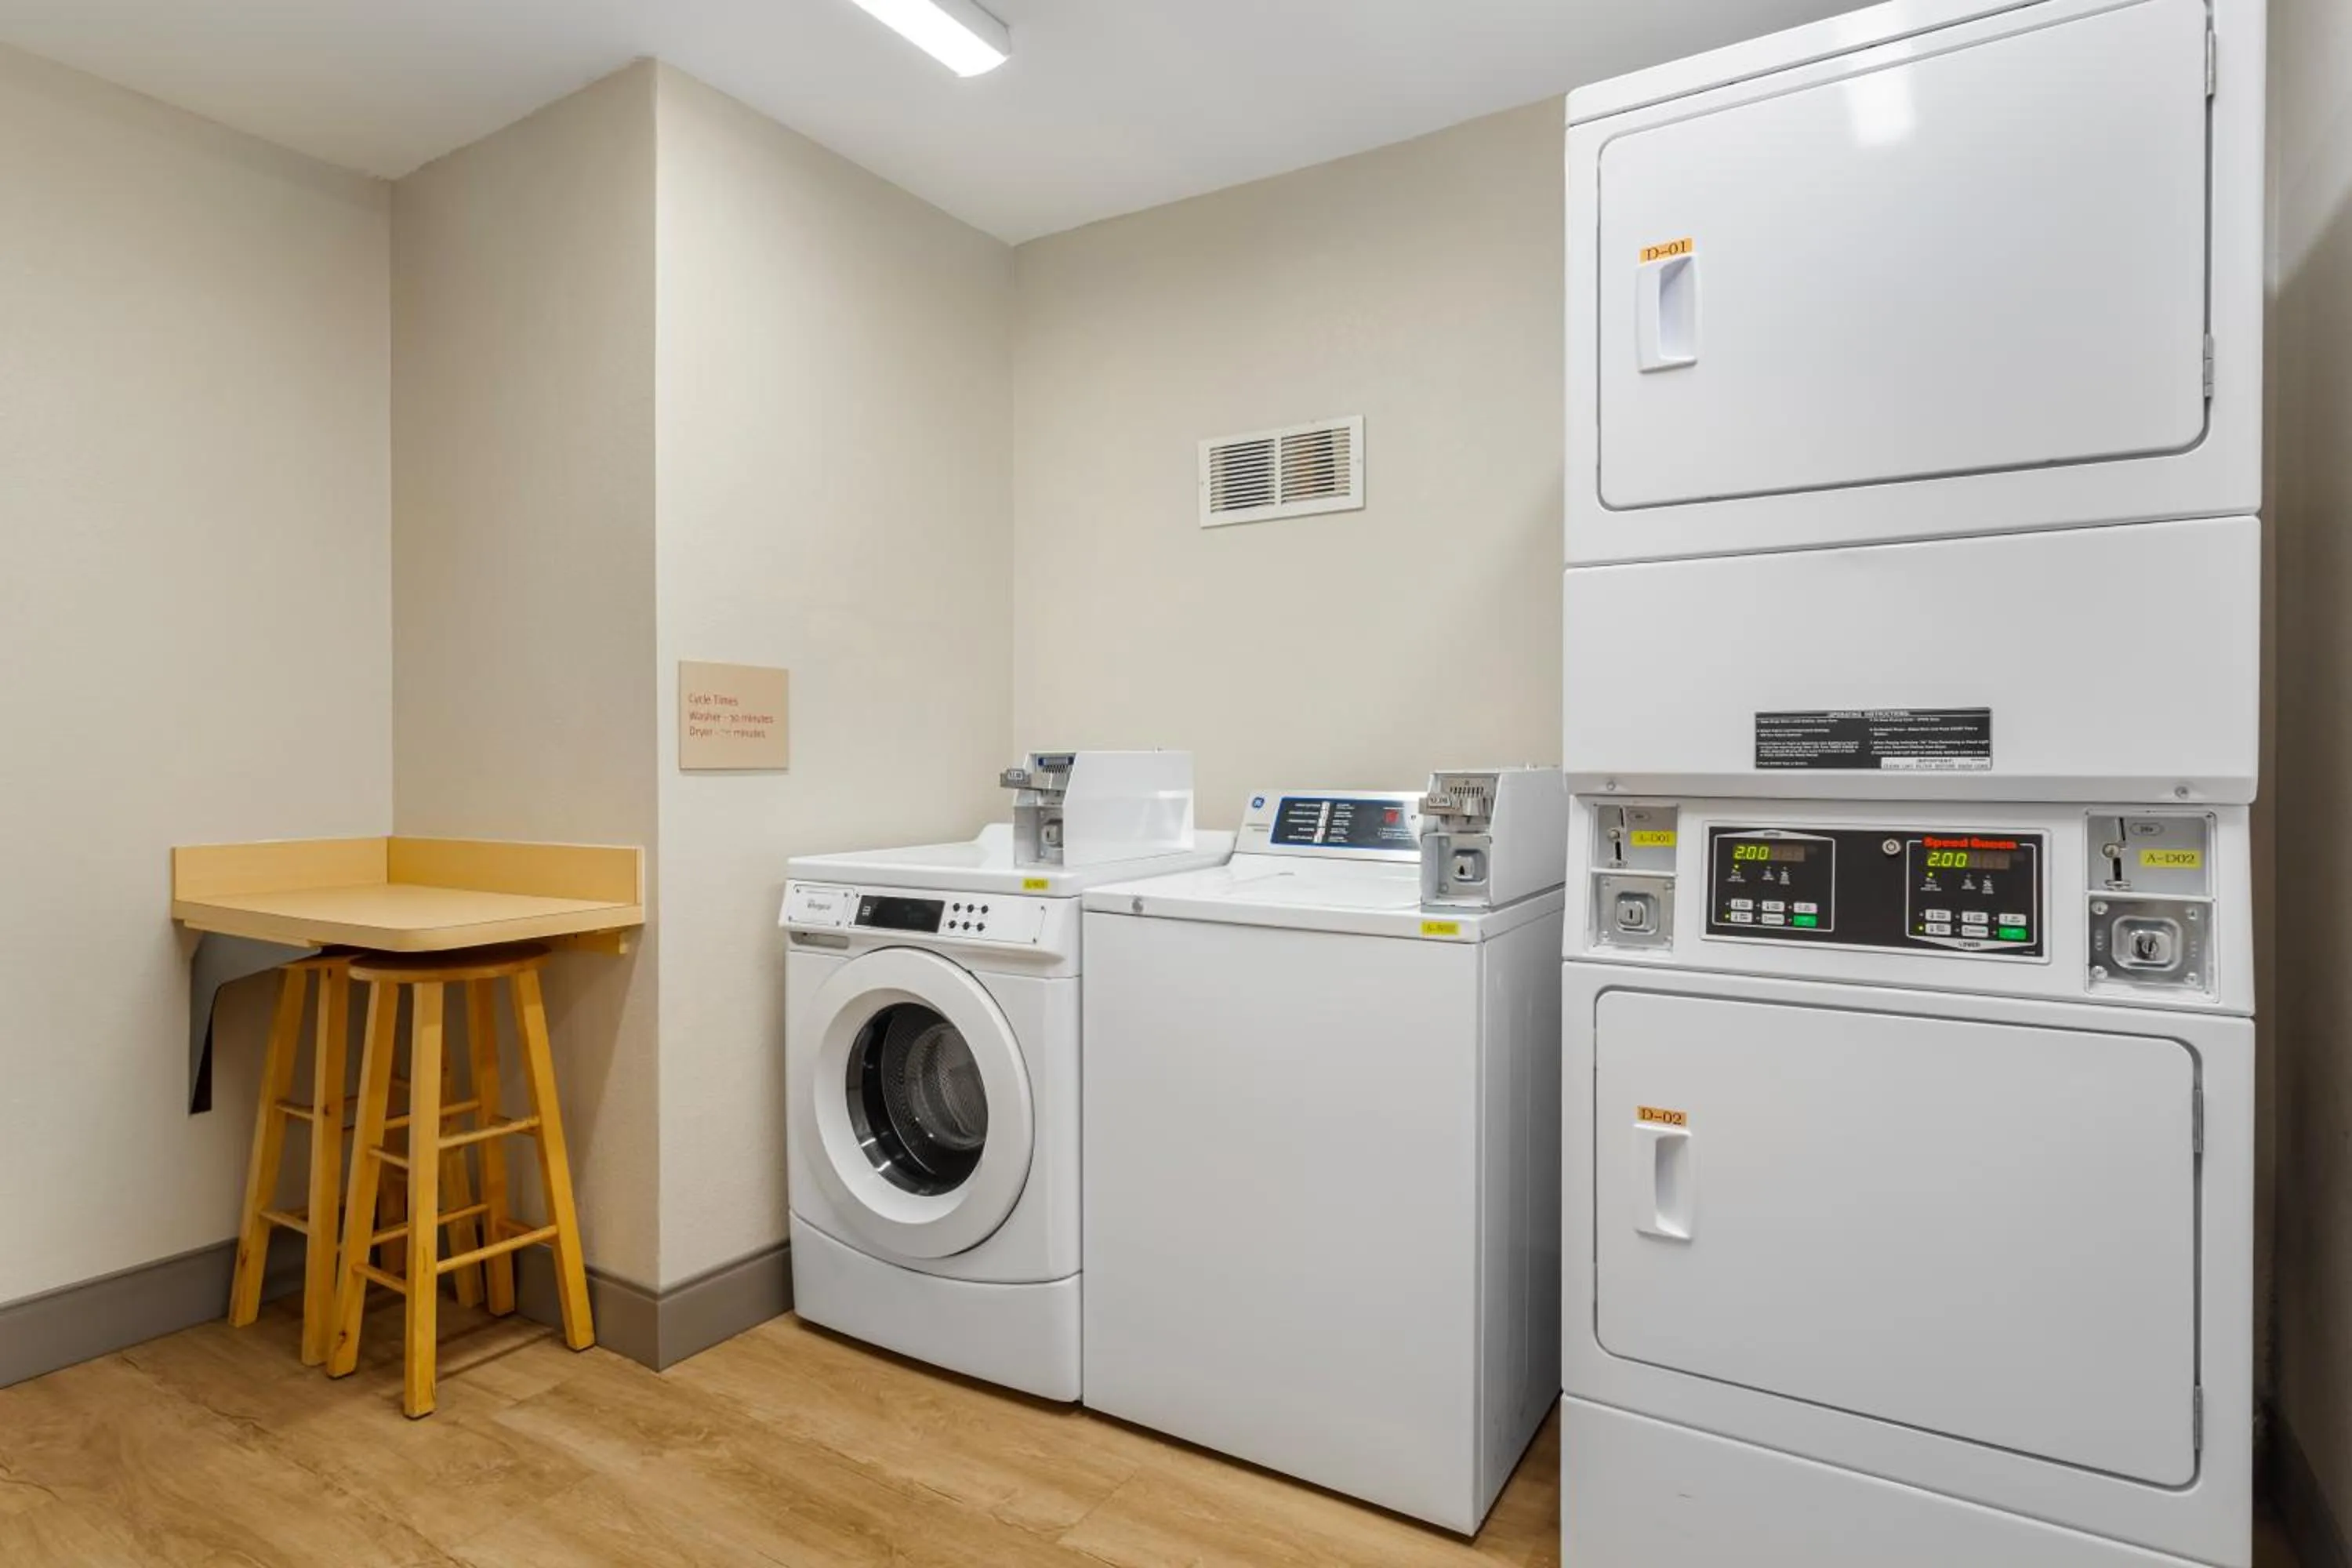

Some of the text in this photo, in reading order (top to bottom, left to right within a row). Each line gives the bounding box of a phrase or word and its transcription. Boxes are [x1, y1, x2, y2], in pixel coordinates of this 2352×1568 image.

[1646, 241, 1686, 260] D-01
[713, 694, 739, 706] Times
[690, 726, 713, 738] Dryer
[1924, 837, 1968, 849] Speed
[1928, 852, 1967, 868] 2.00
[2146, 853, 2195, 864] A-D02
[1642, 1107, 1682, 1125] D-02
